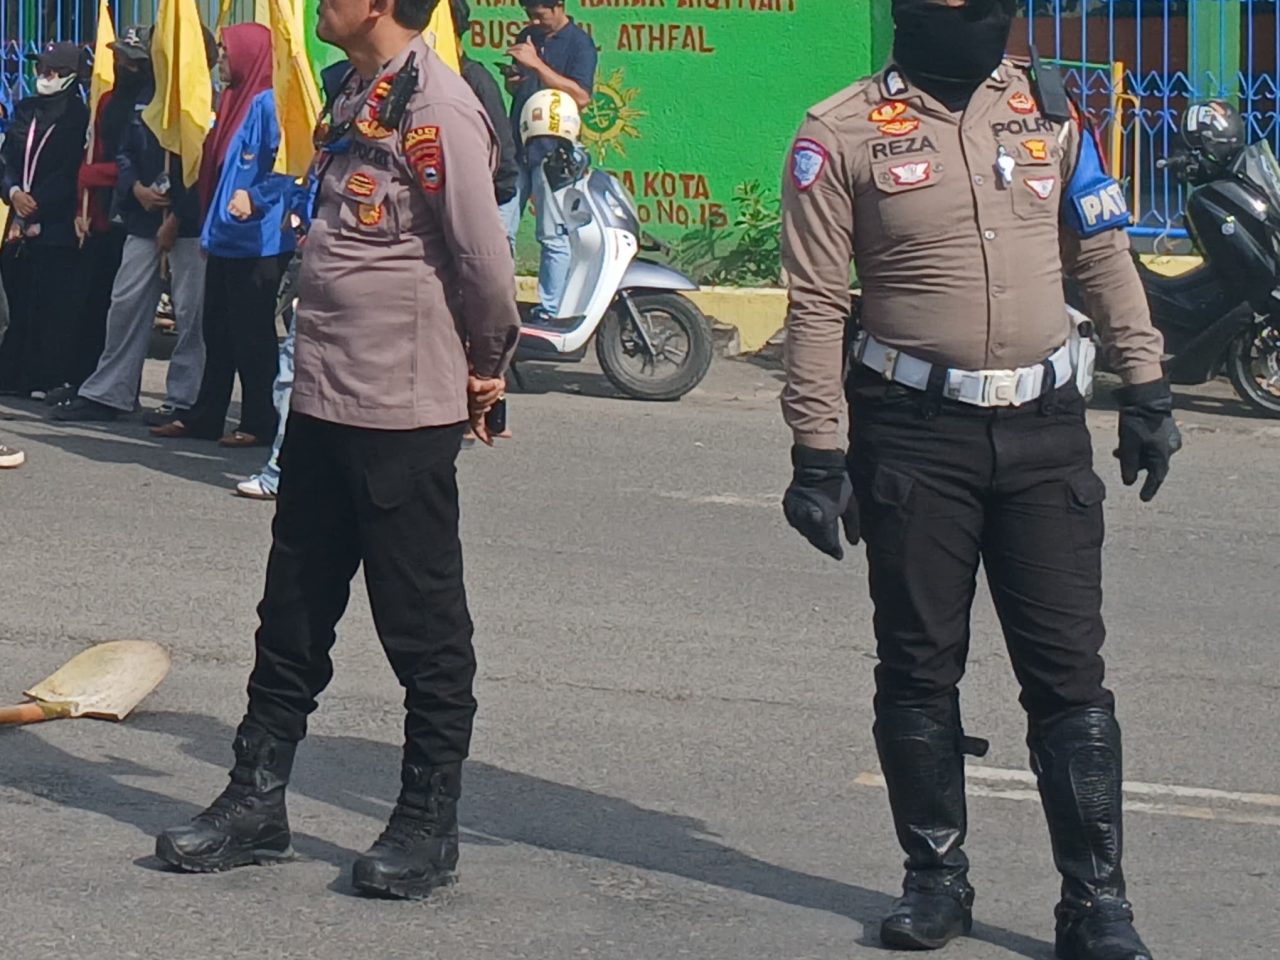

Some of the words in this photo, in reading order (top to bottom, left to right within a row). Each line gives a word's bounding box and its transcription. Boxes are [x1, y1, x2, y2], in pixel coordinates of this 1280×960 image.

[616, 23, 716, 53] ATHFAL
[871, 135, 937, 159] REZA
[643, 170, 710, 201] KOTA
